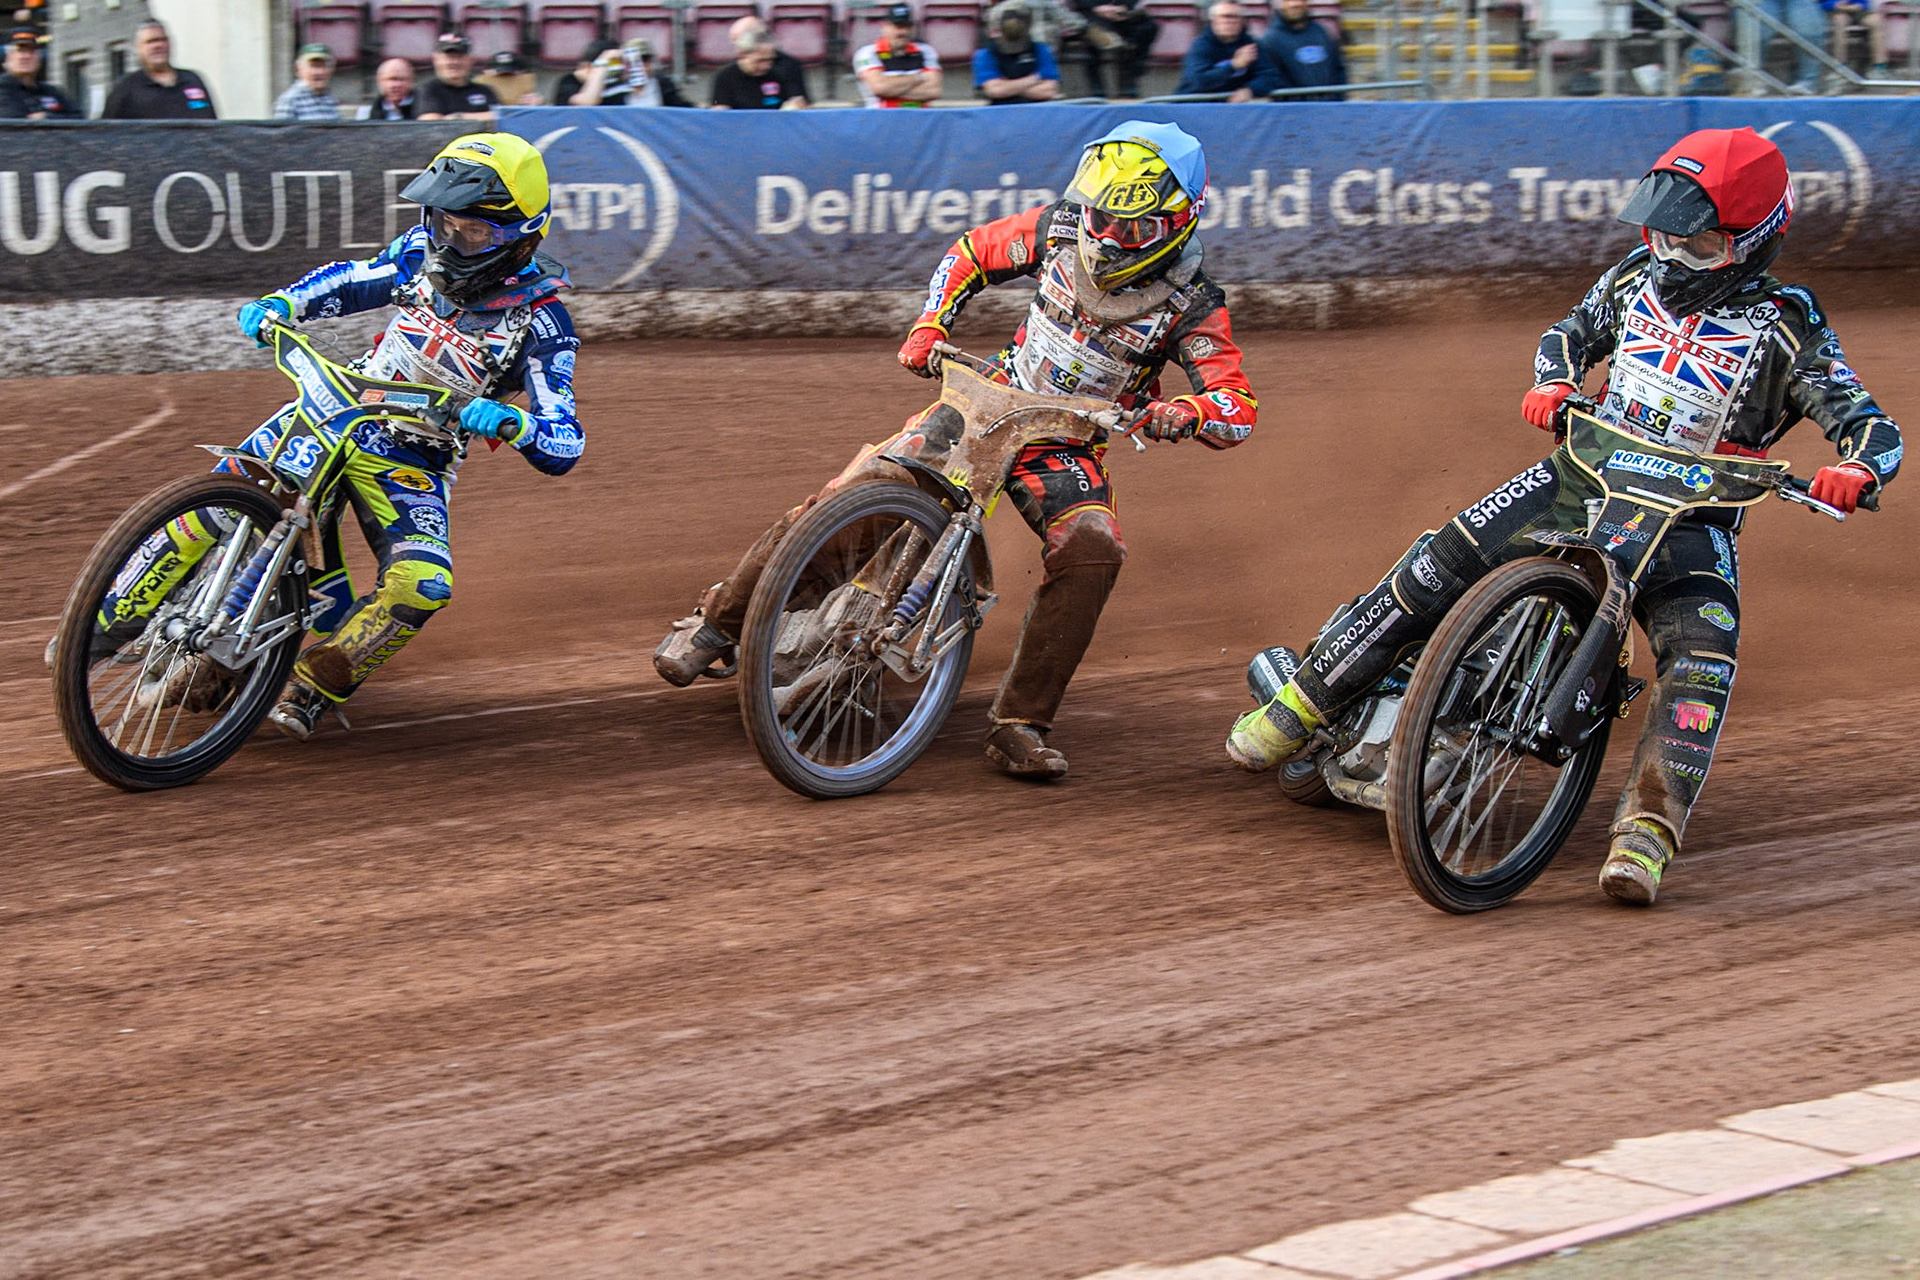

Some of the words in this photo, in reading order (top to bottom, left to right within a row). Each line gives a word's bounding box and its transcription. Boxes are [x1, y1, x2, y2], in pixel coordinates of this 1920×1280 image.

[153, 168, 426, 253] OUTLE
[1197, 168, 1311, 230] orld
[1329, 167, 1493, 226] Class
[1508, 166, 1642, 223] Trav
[1737, 207, 1785, 250] SCOTT
[1749, 305, 1777, 323] 152
[1629, 316, 1741, 374] BRITISH
[1044, 359, 1077, 389] NSSC
[1098, 356, 1126, 374] 2023
[1619, 352, 1691, 394] Championship
[1689, 387, 1724, 408] 2023
[312, 385, 343, 416] FLUX
[1154, 402, 1190, 422] FOX
[1628, 400, 1669, 430] NSSC
[1469, 467, 1553, 529] SHOCKS
[1599, 521, 1651, 544] HAGON
[1331, 593, 1394, 657] PRODUCTS
